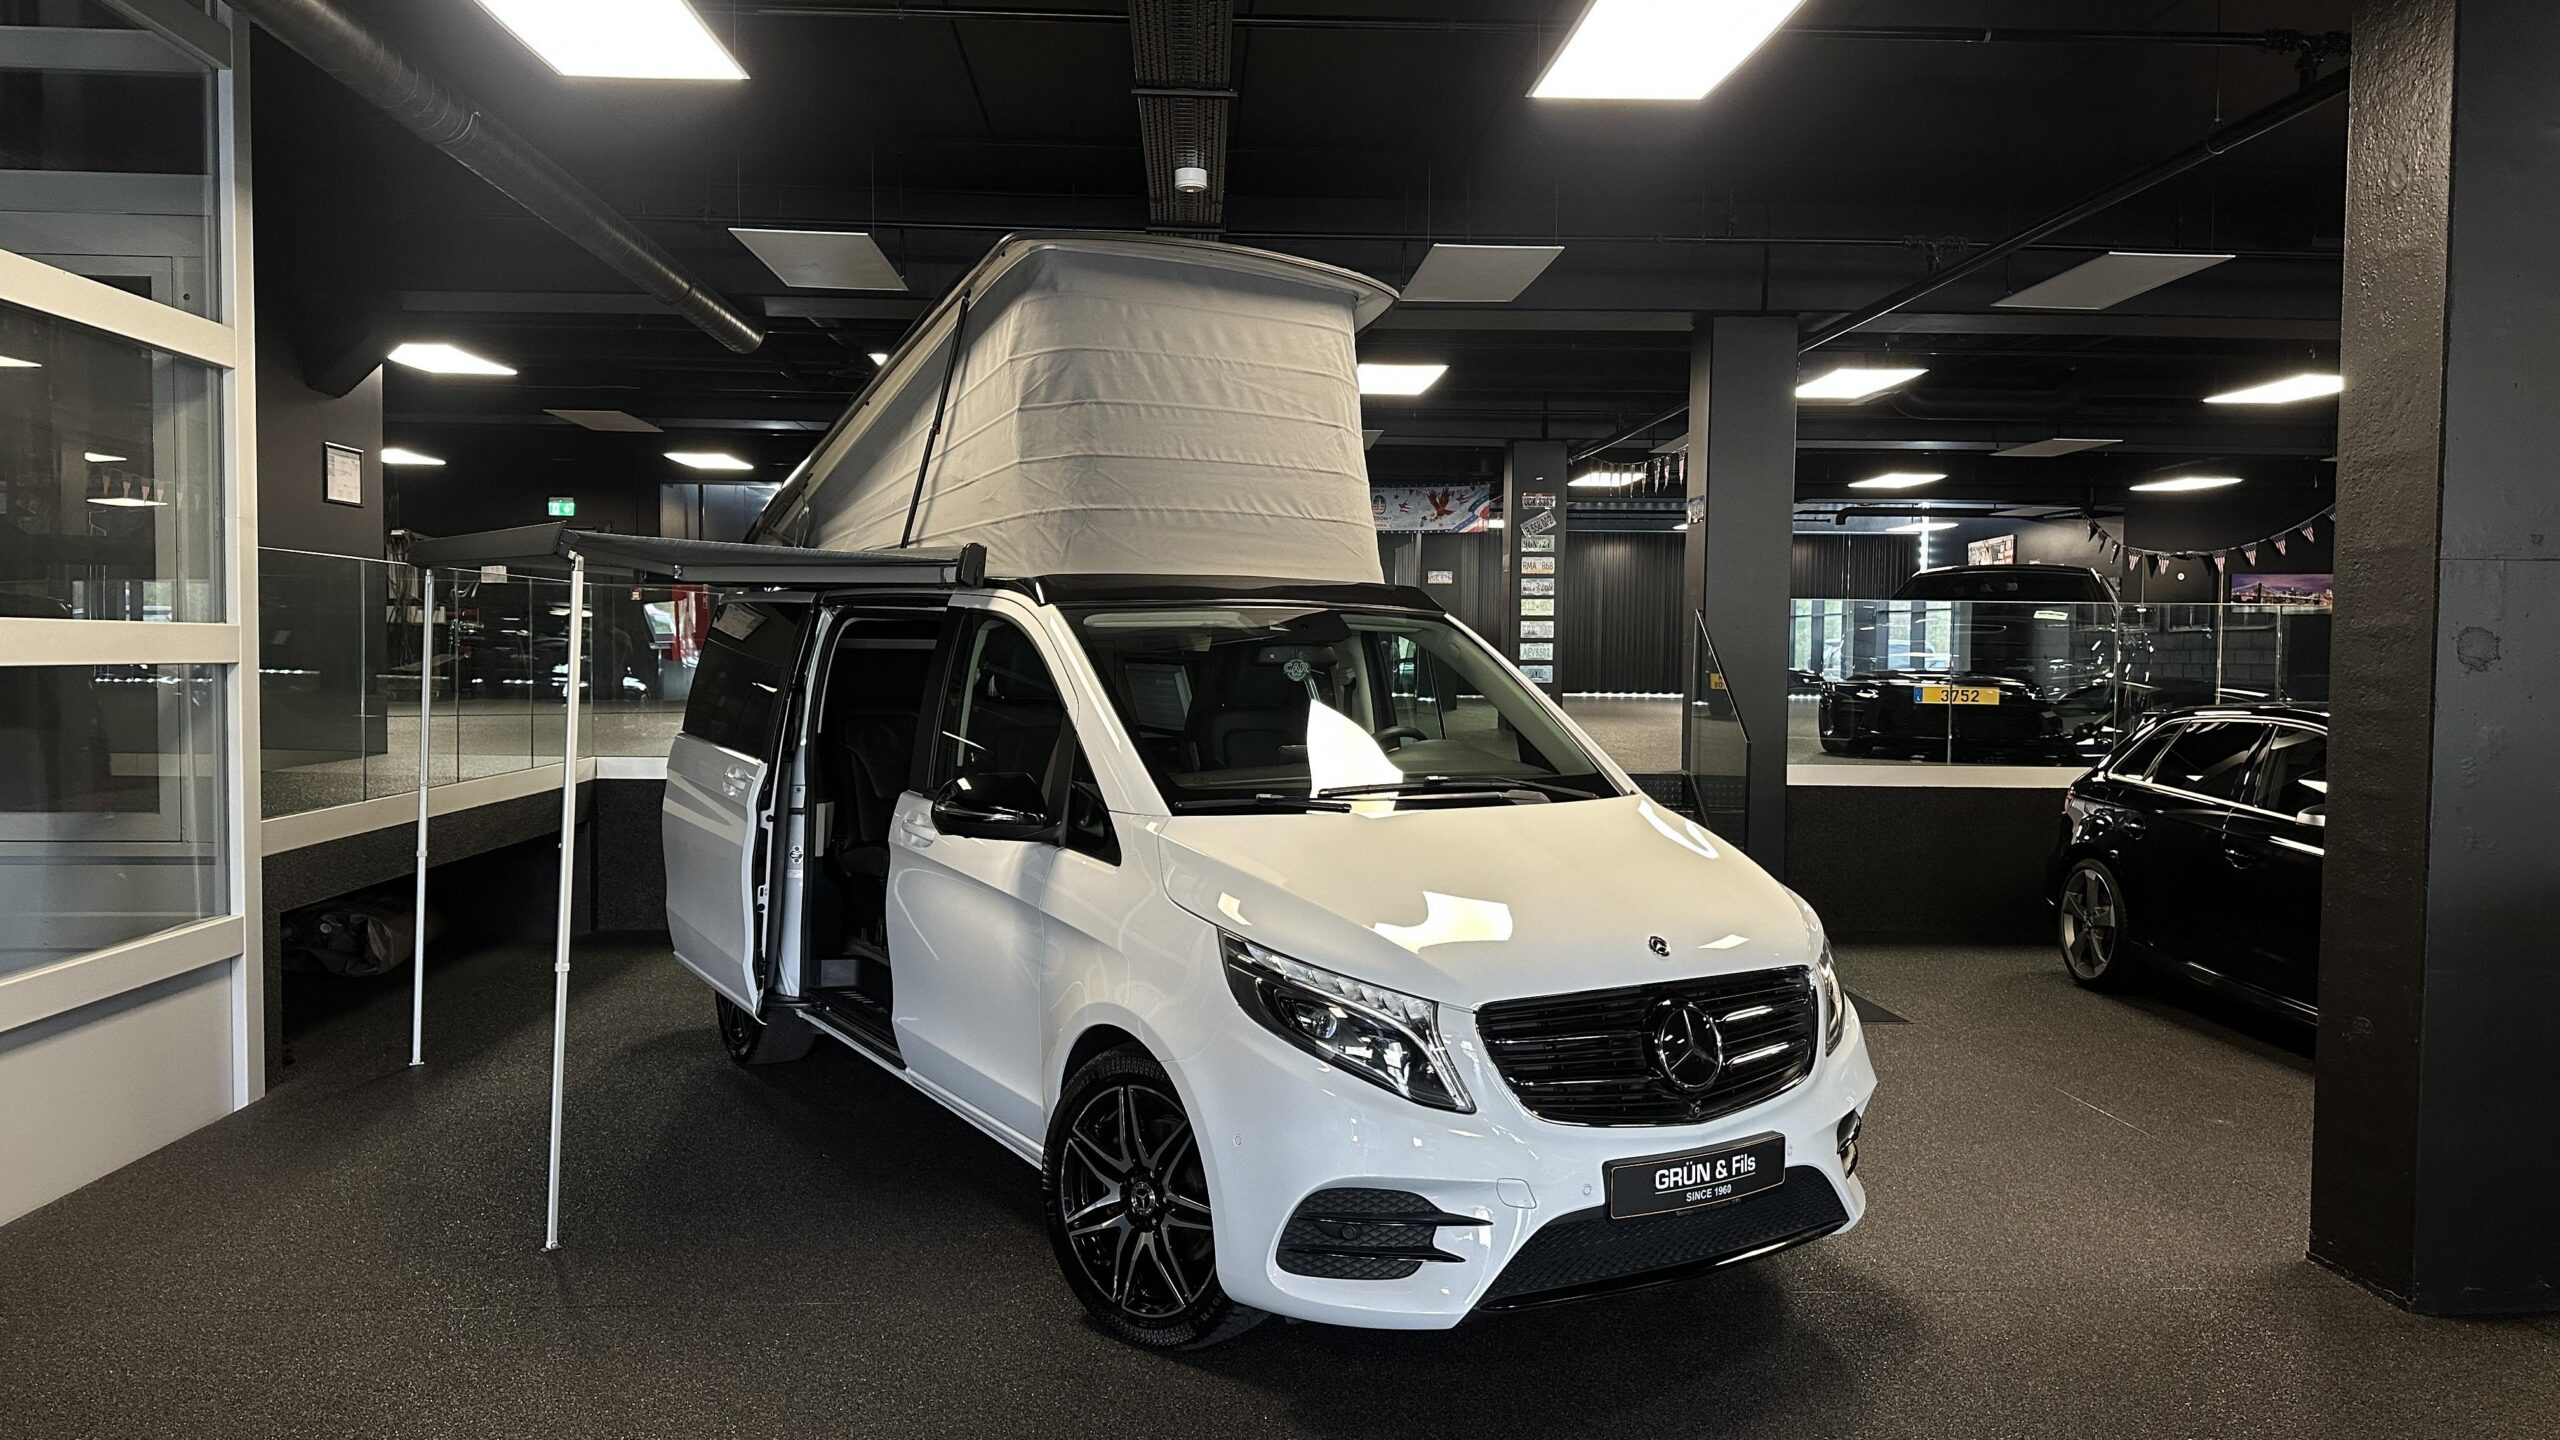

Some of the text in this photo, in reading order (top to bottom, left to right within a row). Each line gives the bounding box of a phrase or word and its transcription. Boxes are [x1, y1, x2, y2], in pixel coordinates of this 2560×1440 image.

[1522, 562, 1537, 570] RMA
[1283, 662, 1309, 673] CAR
[1940, 690, 1979, 702] 3752
[1655, 1153, 1756, 1189] GRÜN & Fils
[1686, 1184, 1732, 1202] SINCE 1960
